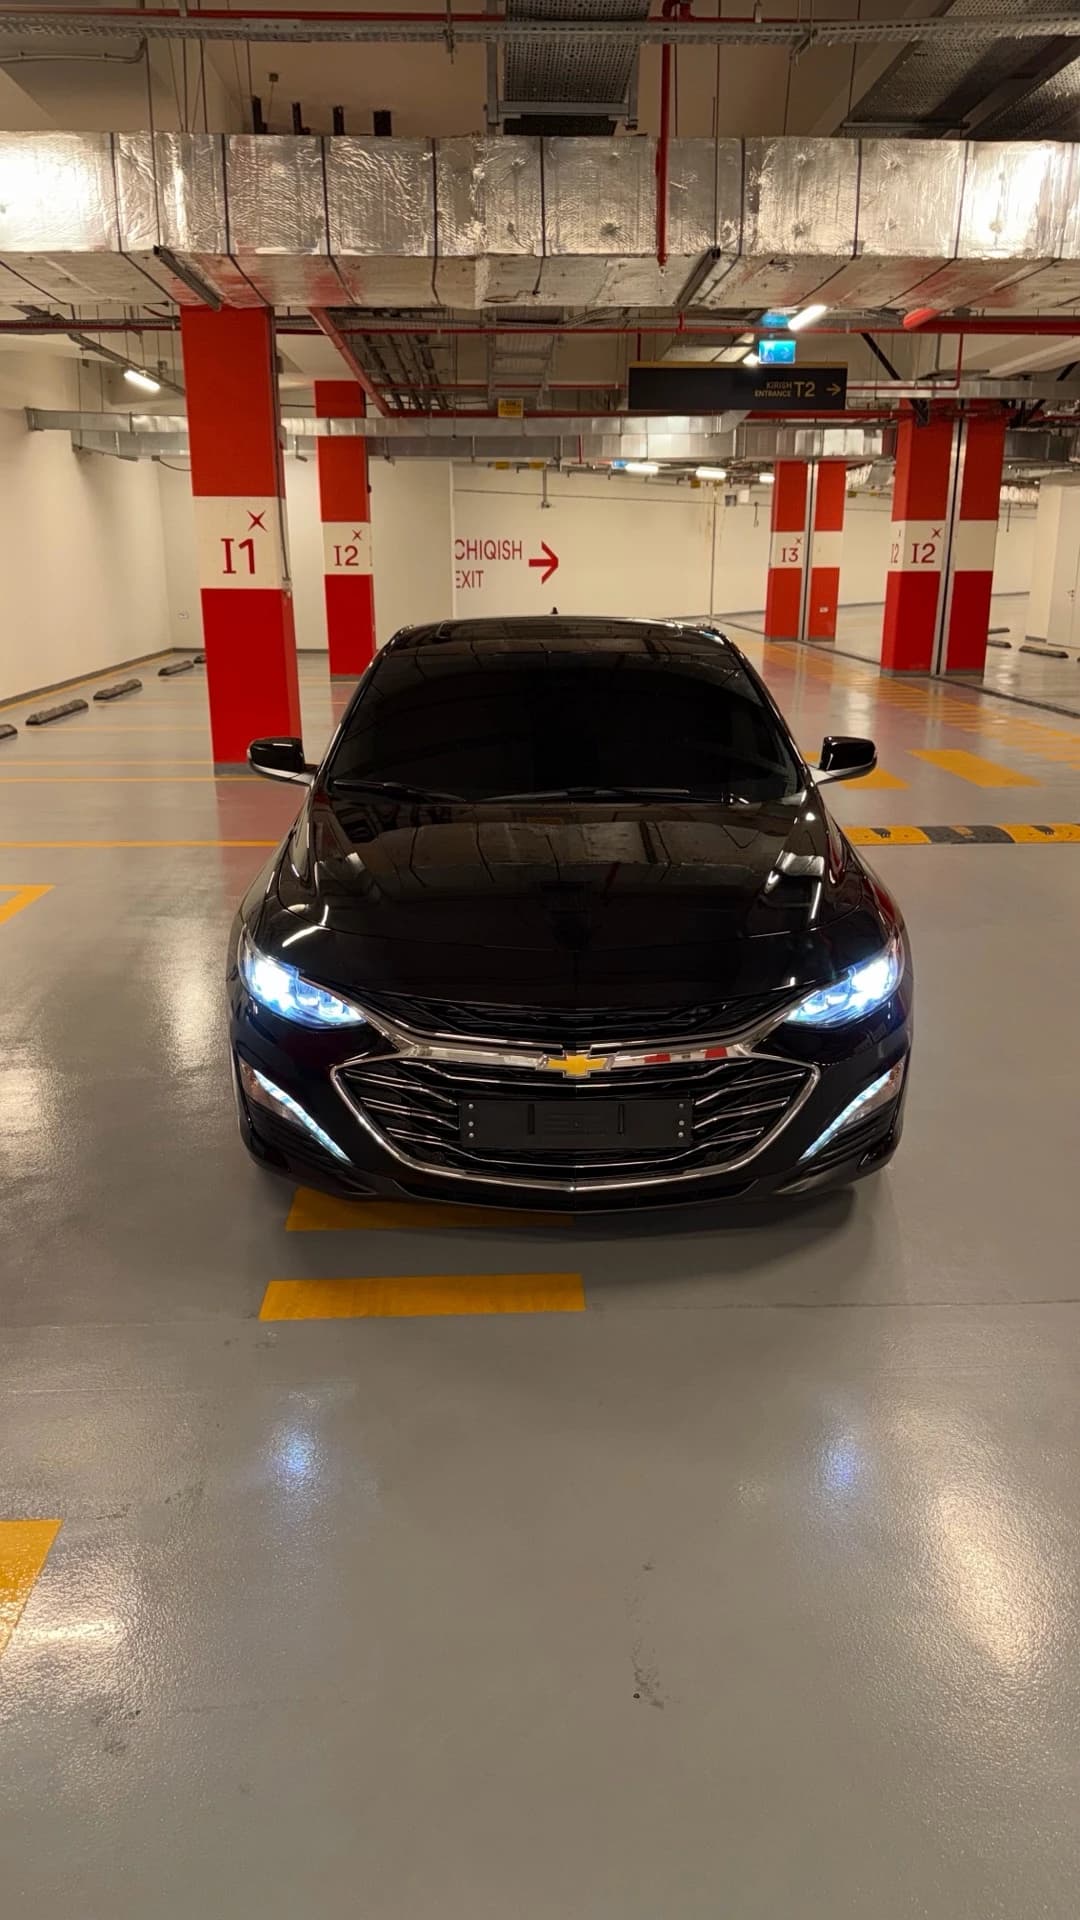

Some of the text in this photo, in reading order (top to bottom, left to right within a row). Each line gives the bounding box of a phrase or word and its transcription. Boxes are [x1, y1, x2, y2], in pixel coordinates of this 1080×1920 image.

[754, 390, 792, 398] ENTRANCE
[794, 381, 816, 398] T2
[221, 538, 255, 575] I1
[333, 545, 360, 566] I2
[455, 539, 522, 560] CHIQISH
[781, 547, 799, 563] I3
[910, 543, 936, 564] I2
